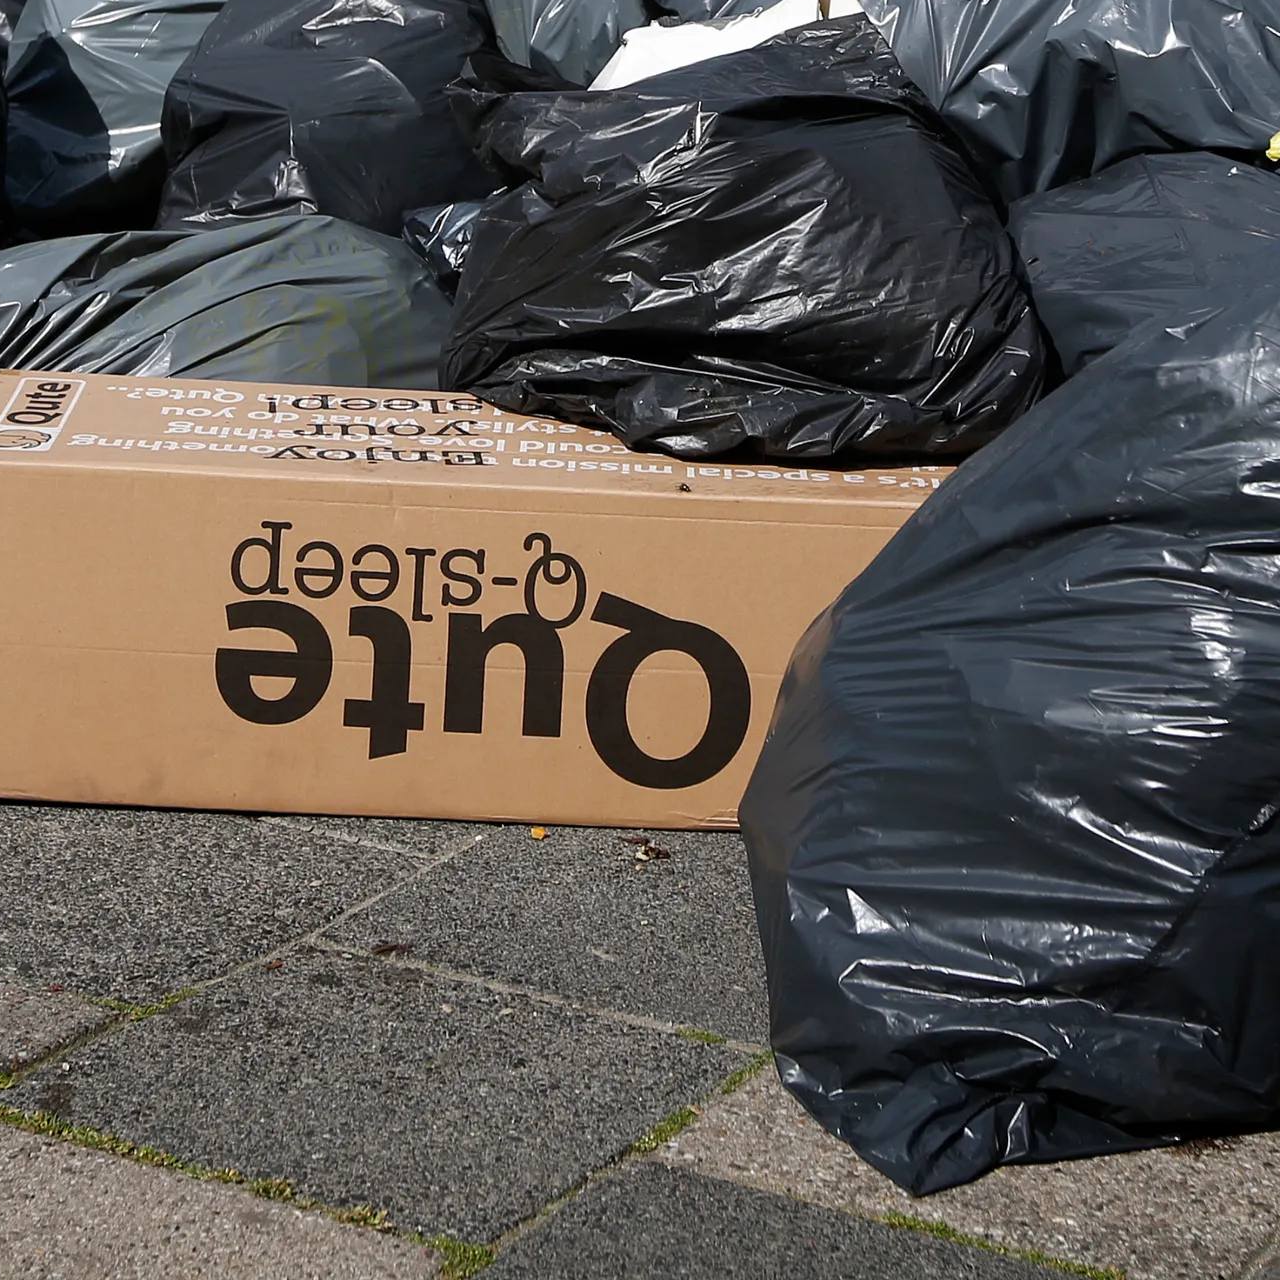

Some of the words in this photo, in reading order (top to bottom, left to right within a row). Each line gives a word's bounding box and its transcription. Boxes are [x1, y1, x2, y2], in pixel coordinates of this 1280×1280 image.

[6, 382, 71, 425] Qute
[160, 405, 236, 419] you
[267, 393, 483, 414] sleep!
[248, 411, 299, 424] do
[293, 420, 480, 437] your
[408, 436, 505, 452] love.
[520, 440, 629, 455] could
[263, 445, 495, 466] Enjoy
[512, 457, 672, 474] mission
[687, 467, 831, 484] special
[842, 473, 865, 484] a
[231, 521, 586, 629] Q-sleep
[215, 591, 751, 790] Qute
